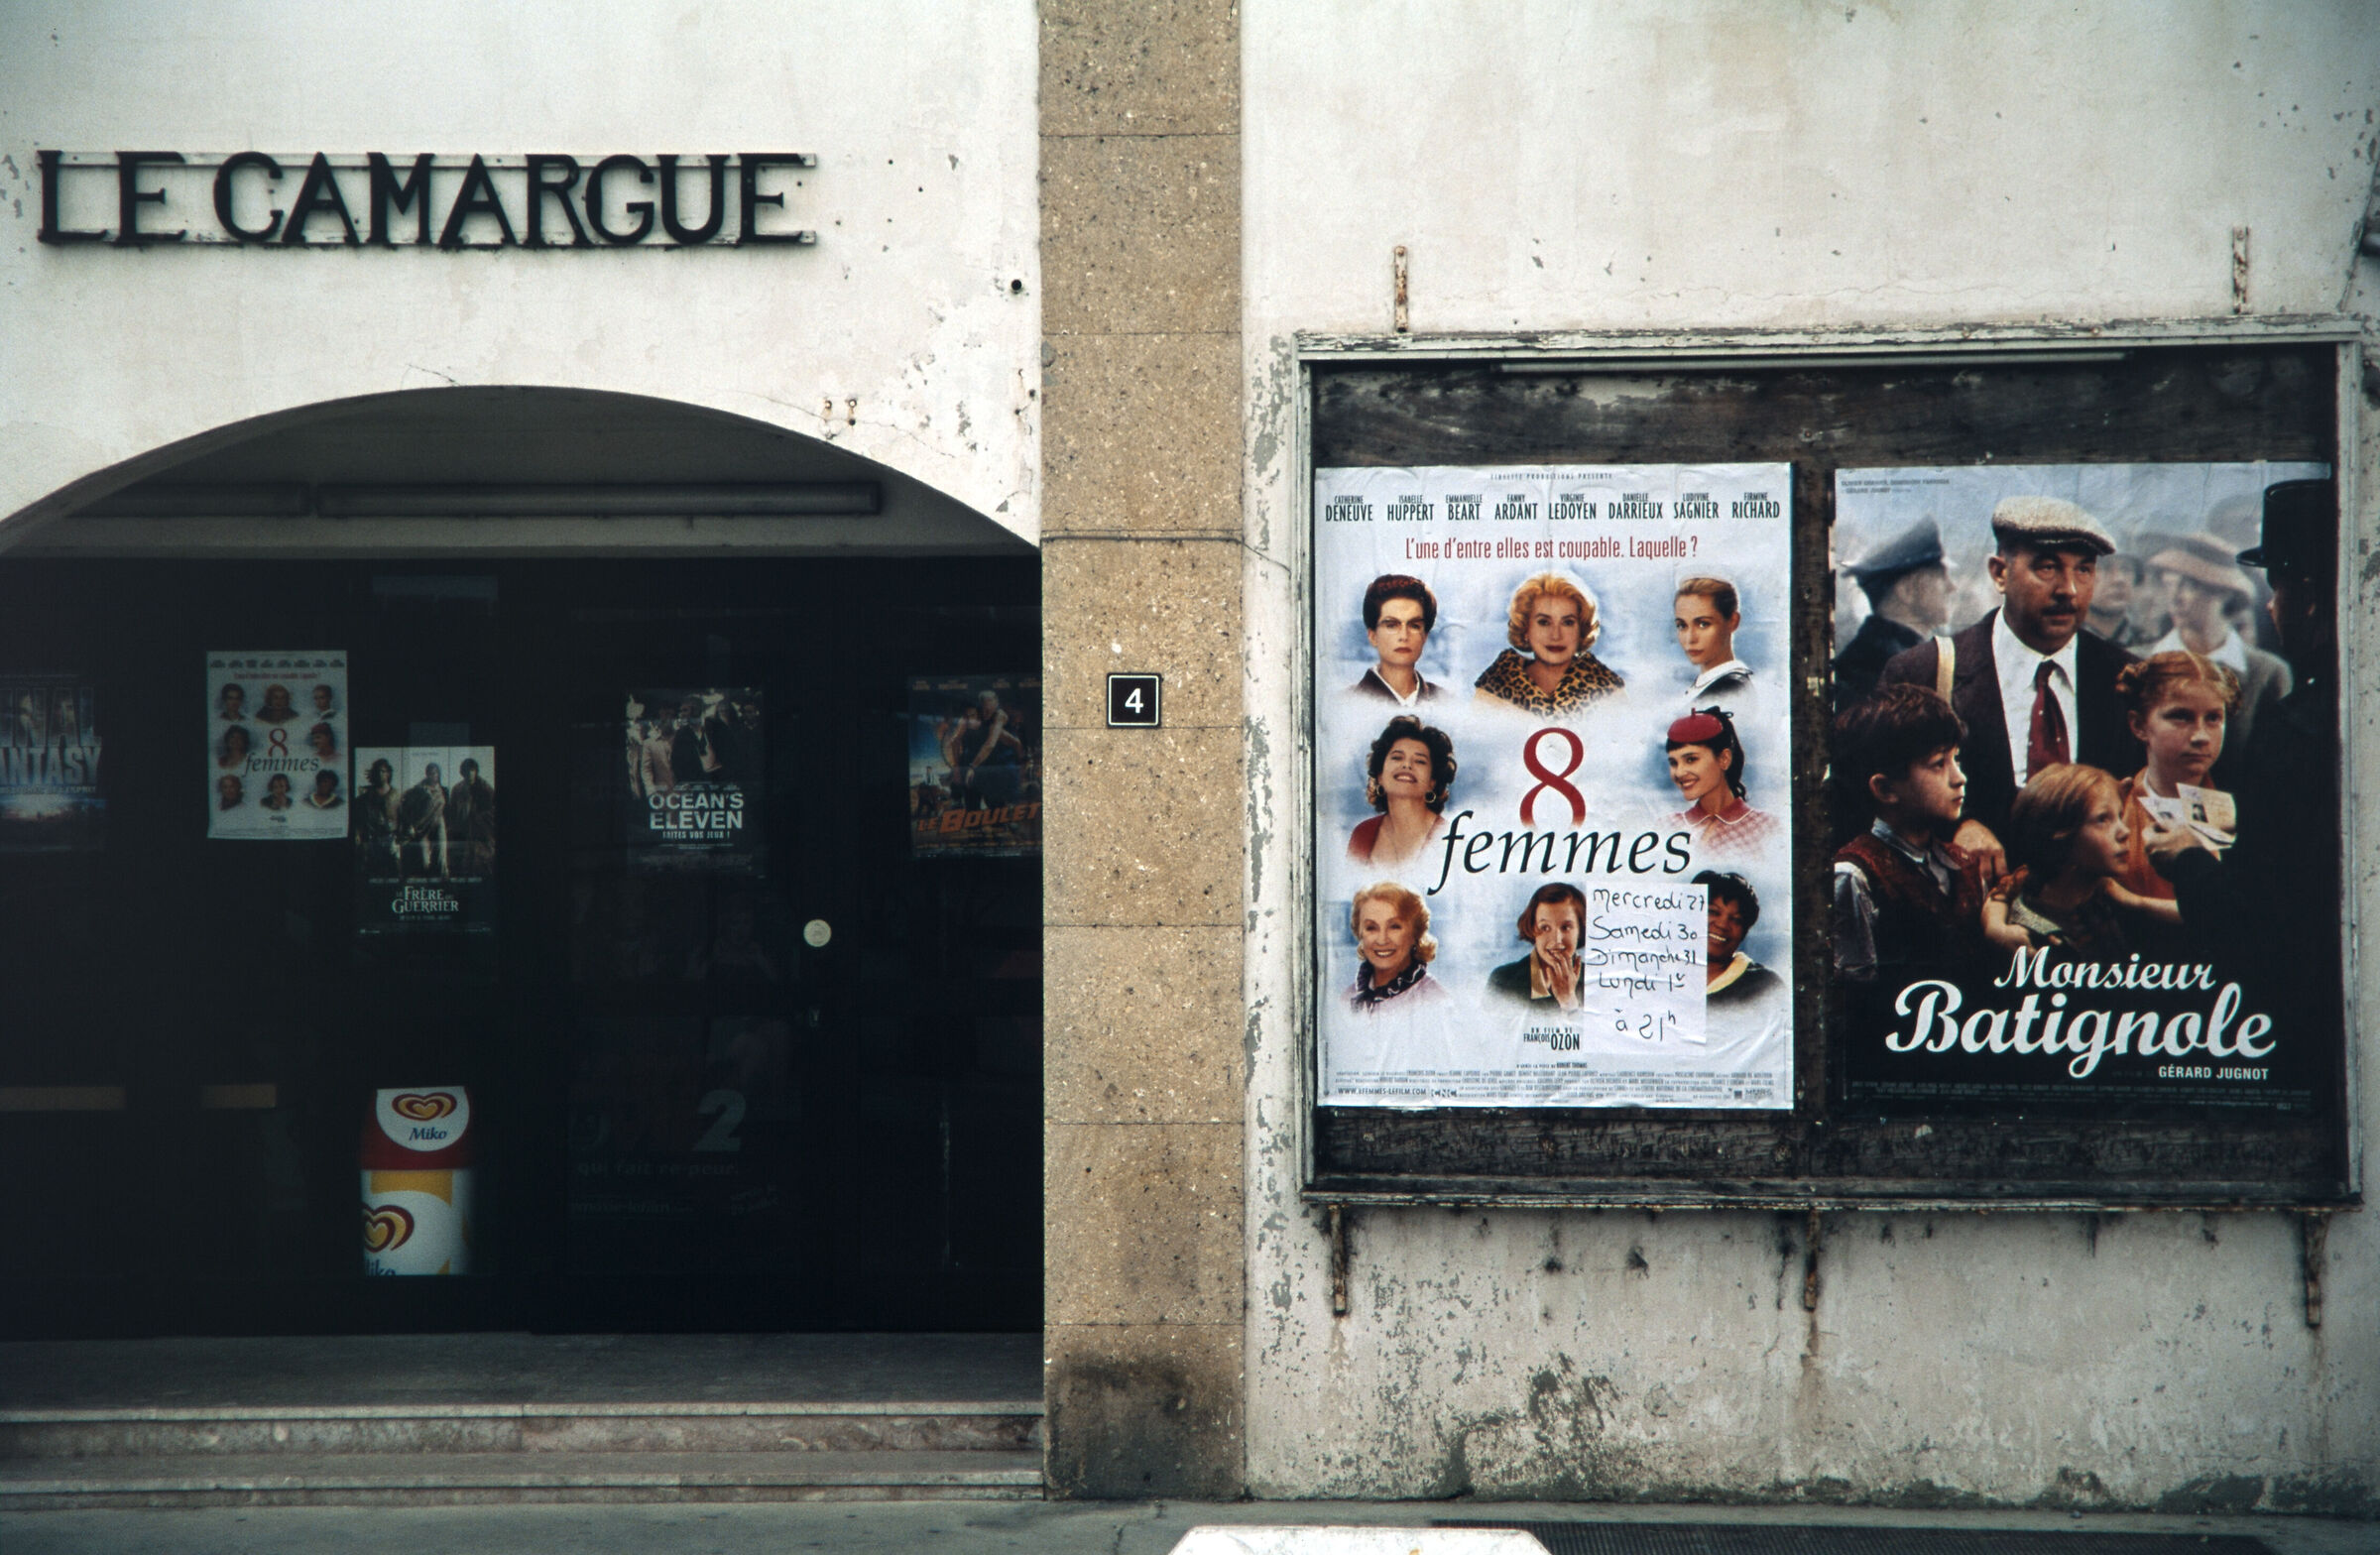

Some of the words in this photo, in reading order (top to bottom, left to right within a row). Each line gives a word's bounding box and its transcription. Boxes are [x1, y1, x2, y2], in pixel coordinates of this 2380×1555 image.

[37, 150, 187, 245] LE
[212, 151, 805, 248] CAMARGUE
[1445, 494, 1483, 503] EMMANUELLE
[1506, 494, 1525, 503] FANNY
[1326, 504, 1373, 522] DENEUVE
[1387, 504, 1434, 521] HUPPERT
[1494, 503, 1538, 521] ARDANT
[1548, 502, 1597, 520] LEDOYEN
[1608, 502, 1663, 520] DARRIEUX
[1674, 501, 1719, 519] SAGNIER
[1731, 501, 1780, 519] RICHARD
[1405, 538, 1439, 559] L'une
[1444, 538, 1491, 558] d'entre
[1496, 537, 1529, 558] elles
[1534, 538, 1554, 558] est
[1559, 537, 1624, 560] coupable.
[1629, 536, 1687, 559] Laquelle
[1691, 536, 1698, 557] ?
[1125, 688, 1143, 713] 4
[268, 728, 289, 757] 8
[242, 752, 319, 778] femmes
[1519, 727, 1587, 828] 8
[649, 792, 745, 809] OCEAN'S
[650, 810, 743, 829] ELEVEN
[917, 817, 938, 832] LE
[939, 802, 1041, 834] BOULET
[1427, 809, 1692, 896] femmes
[392, 898, 459, 913] GUERRIER
[1589, 915, 1672, 942] Samedi
[1678, 923, 1698, 940] 30
[1586, 945, 1682, 971] Dimanche
[1684, 950, 1696, 965] 31
[1993, 945, 2216, 991] Monsieur
[1599, 972, 1658, 999] Lundi
[1614, 1009, 1628, 1031] à
[1885, 980, 2276, 1078] Batignole
[1550, 1033, 1580, 1050] OZON
[2158, 1064, 2212, 1079] GÉRARD
[2215, 1067, 2270, 1081] JUGNOT
[692, 1089, 747, 1151] 2
[410, 1127, 446, 1140] Miko
